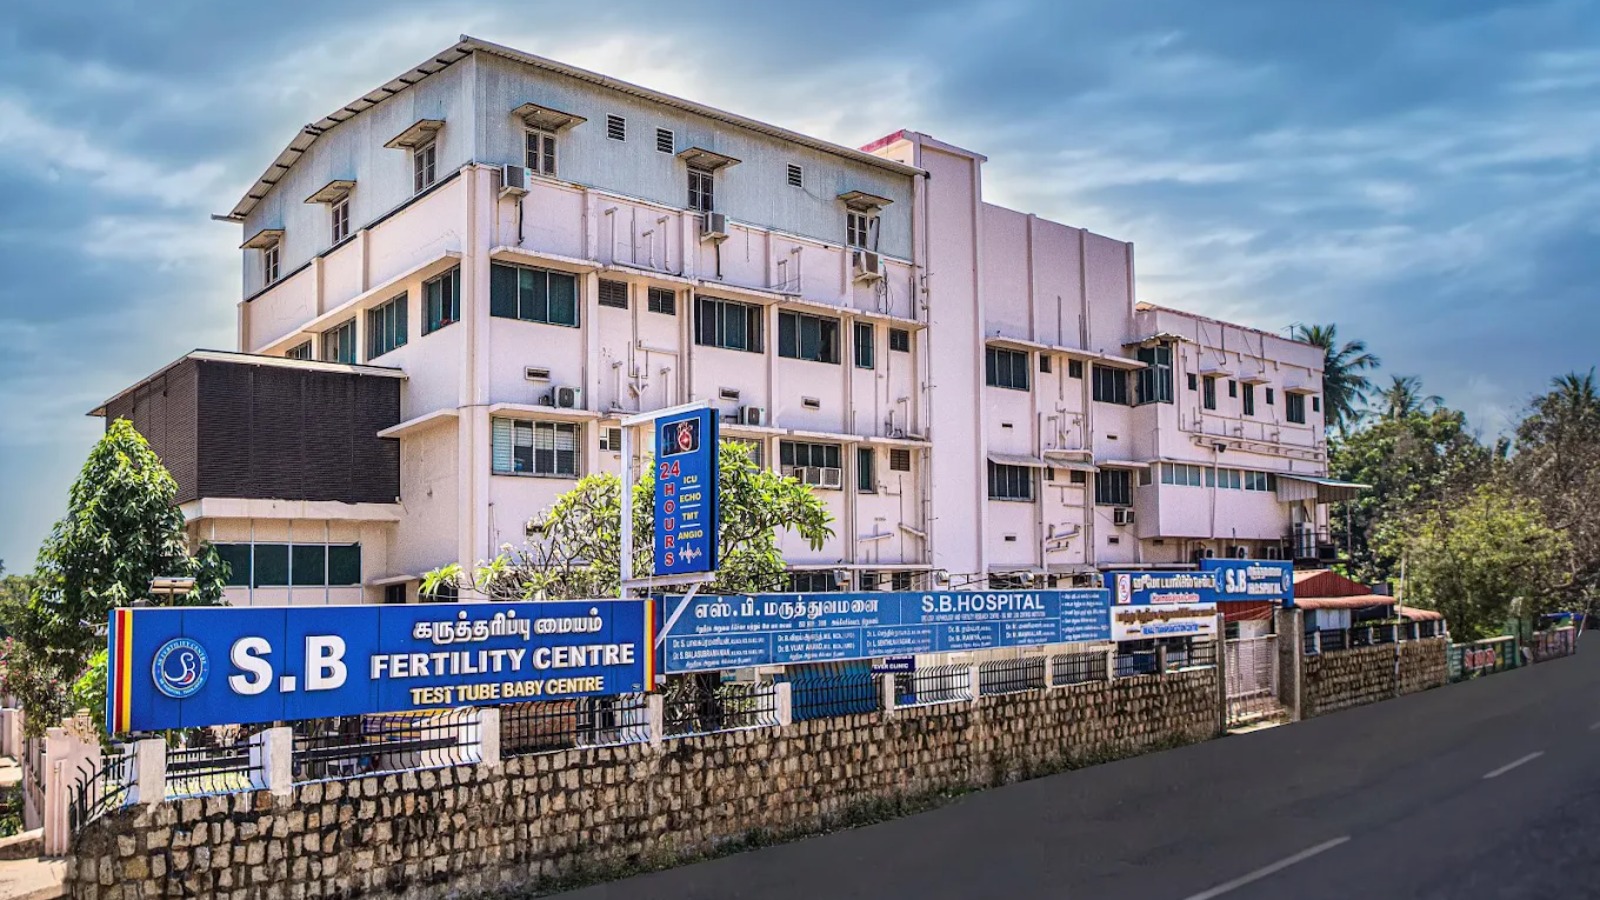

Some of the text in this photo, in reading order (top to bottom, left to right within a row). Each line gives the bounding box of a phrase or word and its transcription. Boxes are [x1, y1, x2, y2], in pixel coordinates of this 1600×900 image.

[661, 461, 680, 480] 24
[684, 476, 697, 484] ICU
[680, 493, 701, 503] ECHO
[664, 482, 675, 566] HOURS
[682, 512, 699, 521] TMT
[678, 530, 703, 540] ANGIO
[1226, 569, 1247, 593] S.B
[414, 608, 603, 645] கருத்தரிப்பு மையம்
[229, 635, 348, 695] S.B
[371, 644, 635, 680] FERTILITY CENTRE
[410, 677, 604, 705] TEST TUBE BABY CENTRE
